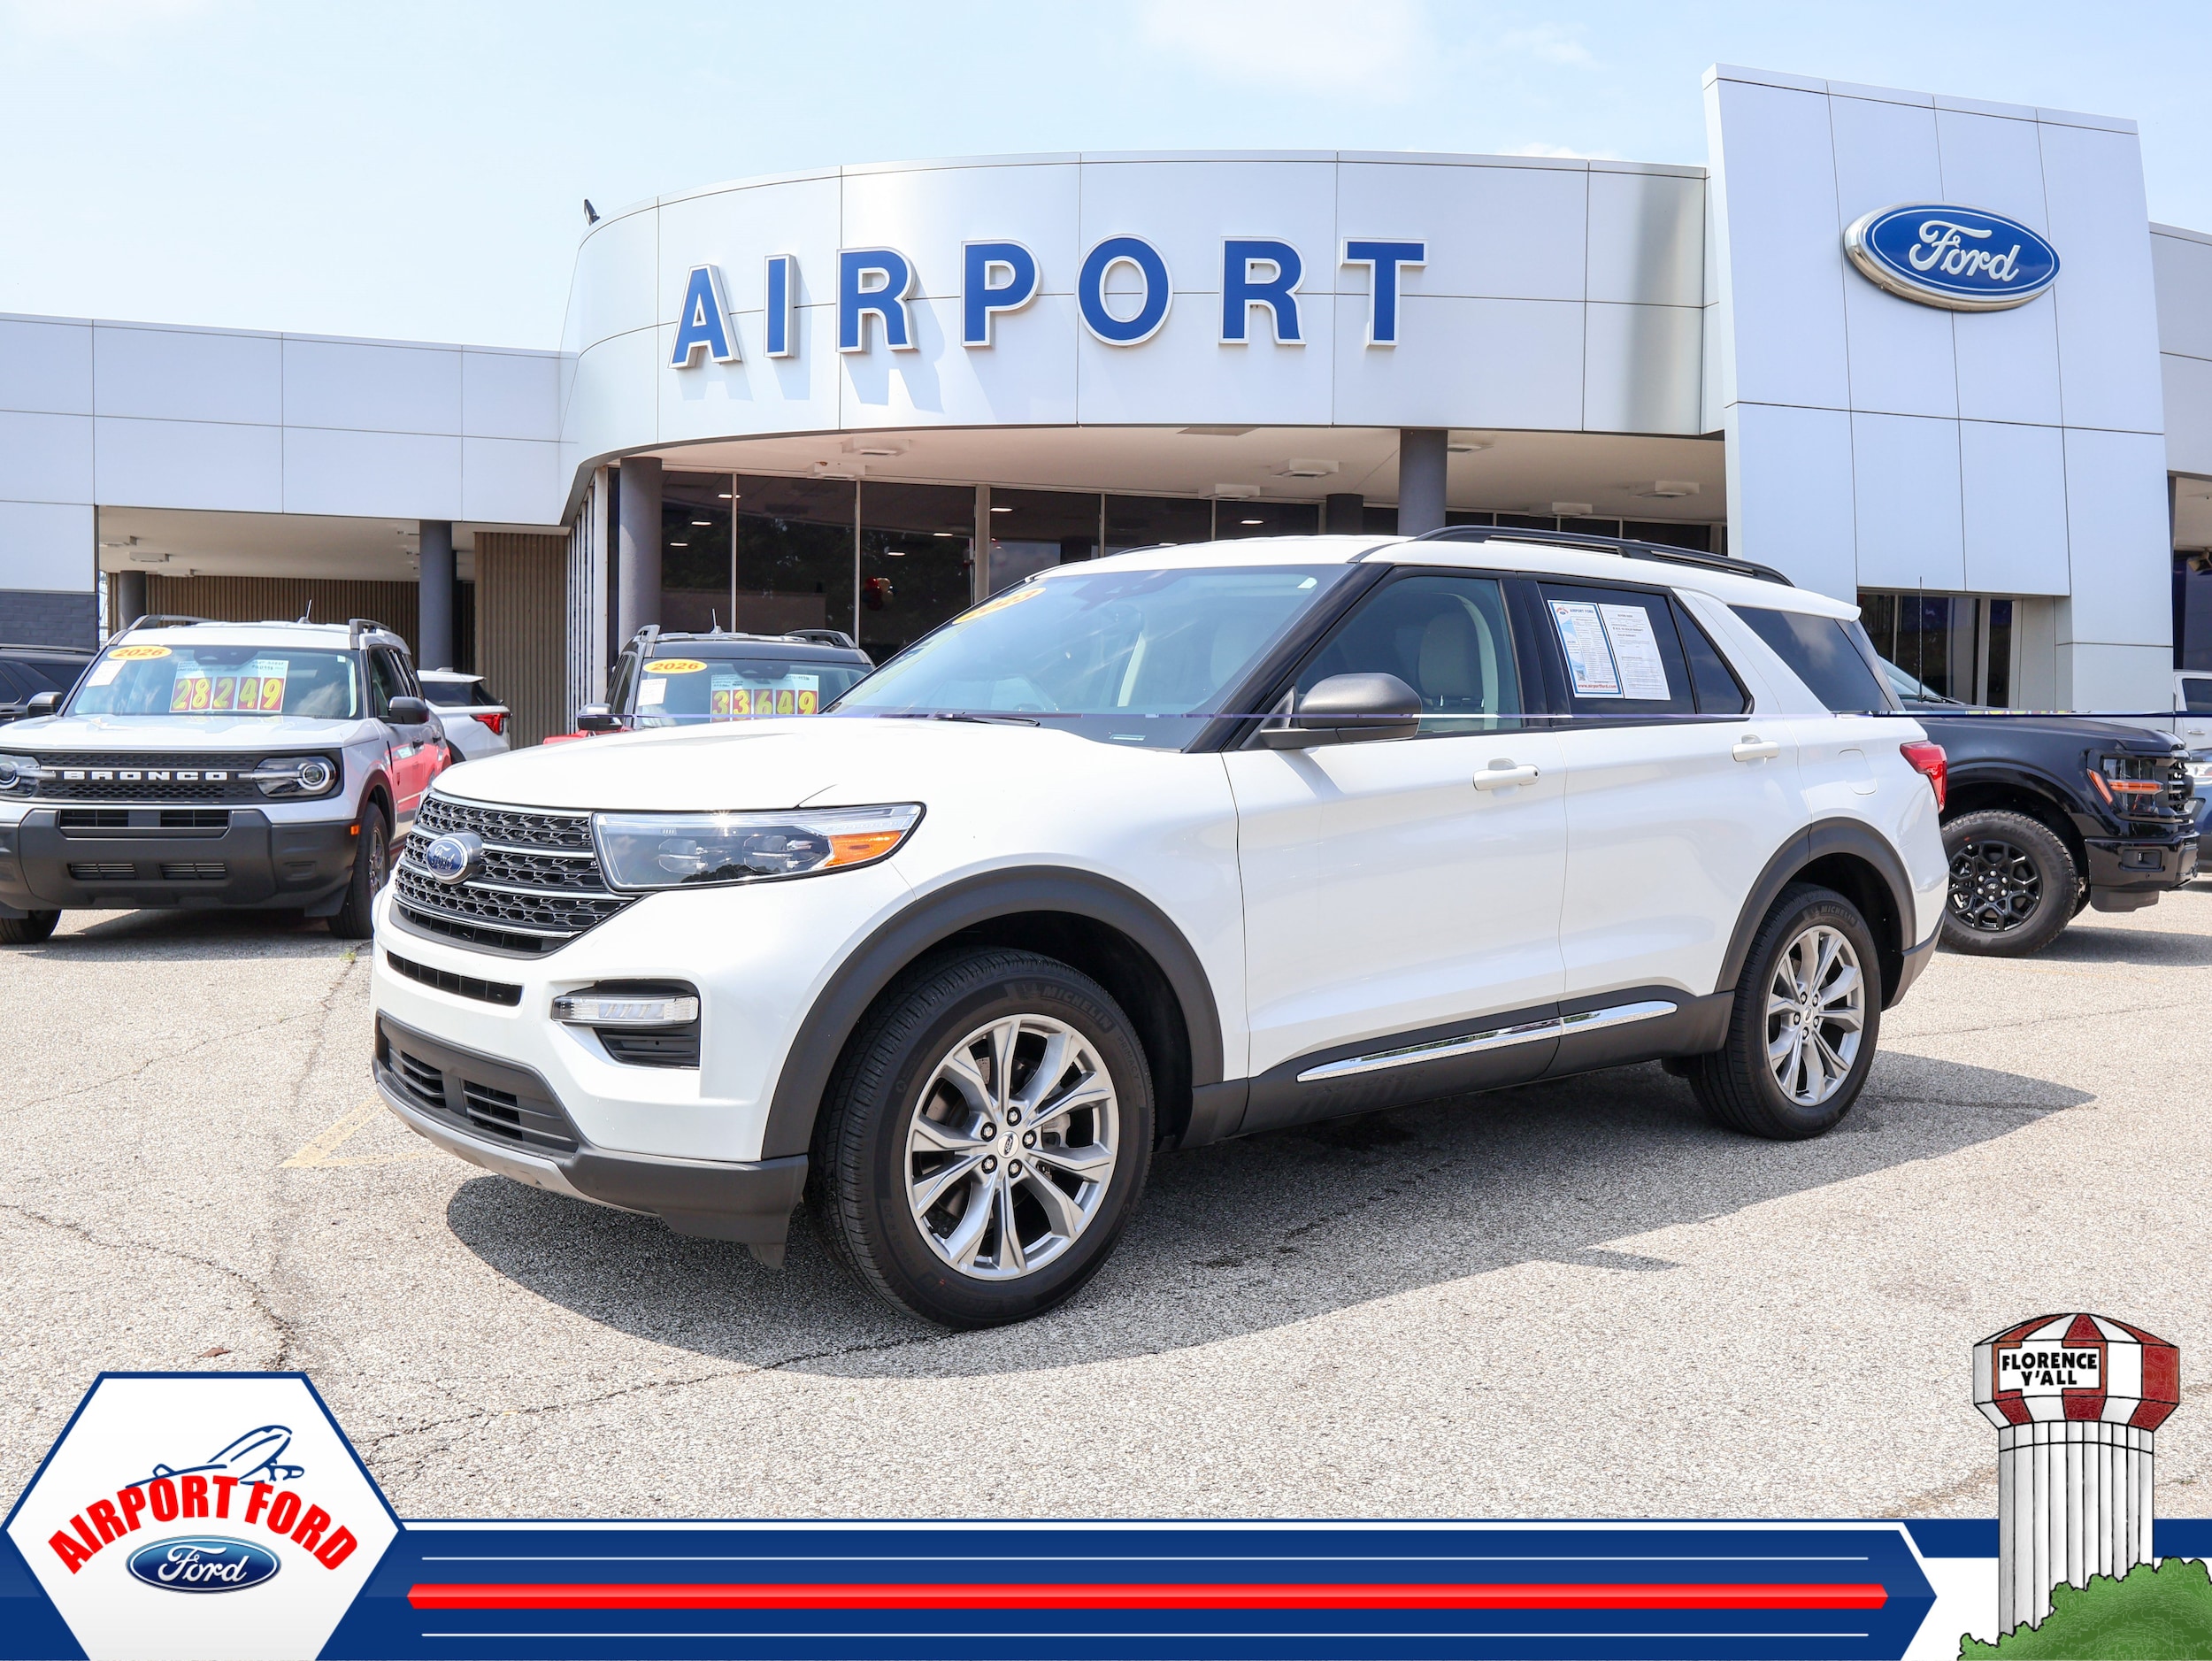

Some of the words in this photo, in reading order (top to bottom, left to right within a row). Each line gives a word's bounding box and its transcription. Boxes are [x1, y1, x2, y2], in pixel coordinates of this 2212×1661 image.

[1909, 219, 2022, 282] Ford
[670, 234, 1429, 368] AIRPORT
[115, 648, 164, 657] 2026
[651, 662, 699, 671] 2026
[172, 678, 283, 709] 28249
[712, 690, 816, 719] 33649
[63, 770, 229, 781] BRONCO
[431, 843, 457, 871] Ford
[1820, 905, 1856, 925] MICHELIN
[1042, 985, 1114, 1030] MICHELIN
[1118, 1034, 1141, 1080] PRIMACY
